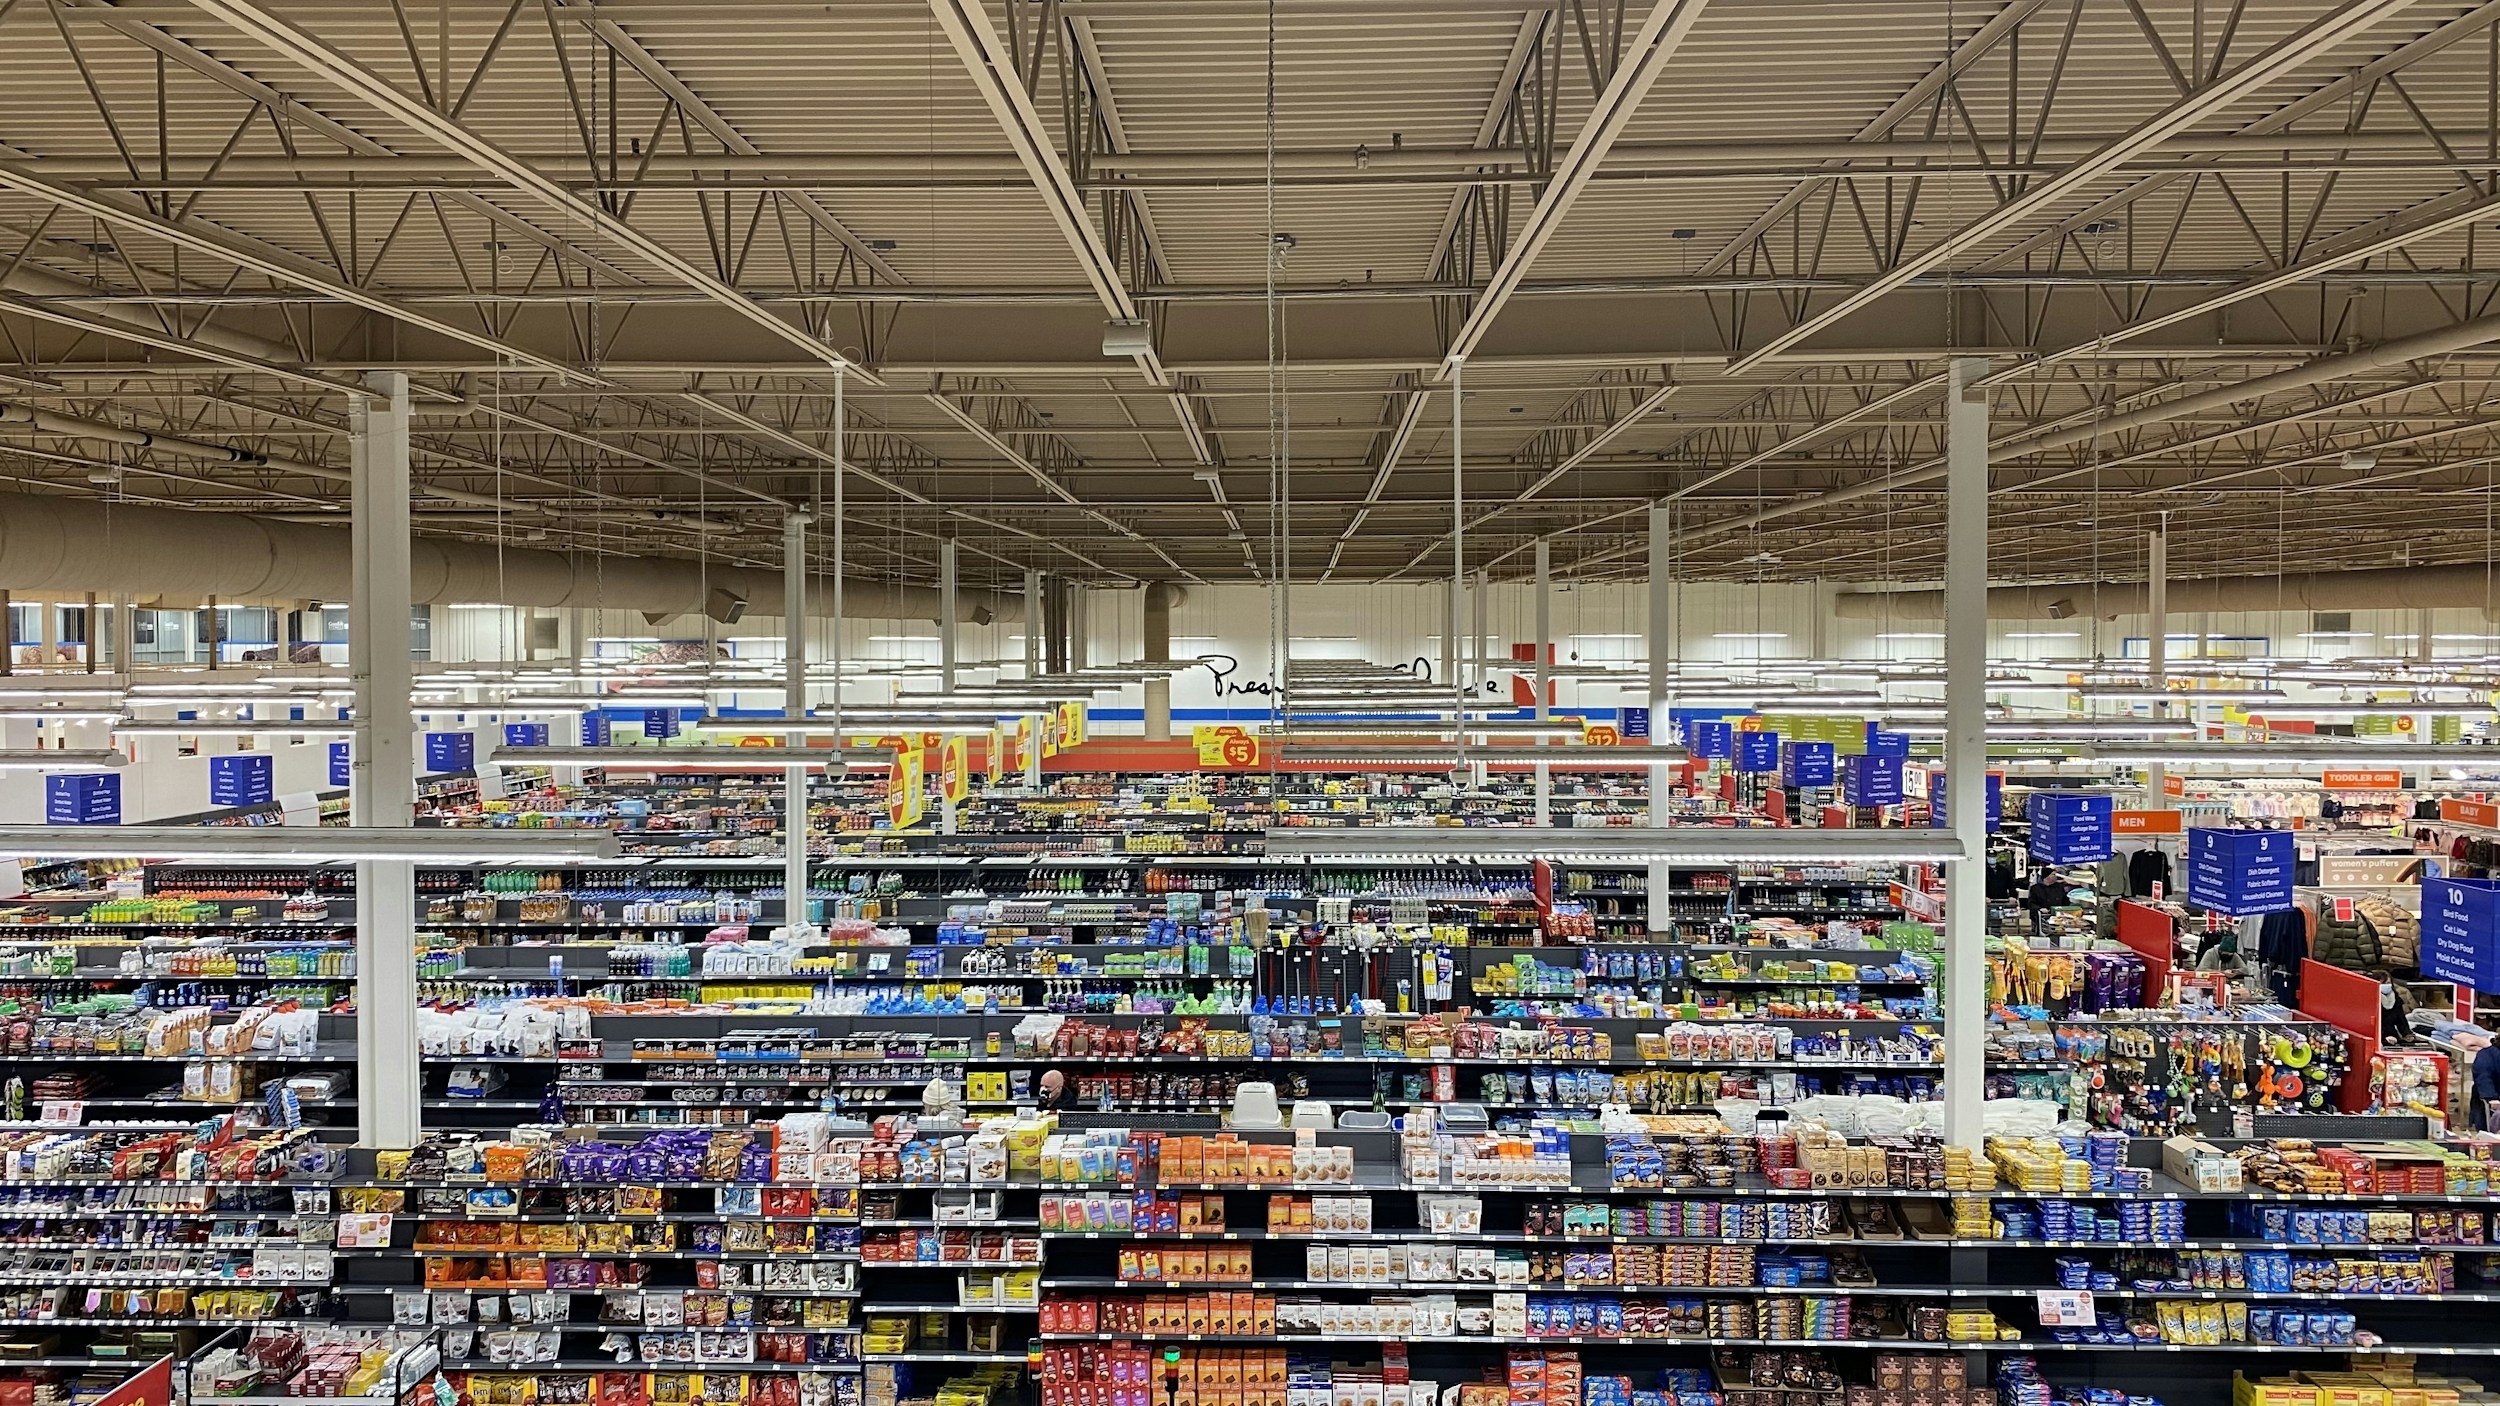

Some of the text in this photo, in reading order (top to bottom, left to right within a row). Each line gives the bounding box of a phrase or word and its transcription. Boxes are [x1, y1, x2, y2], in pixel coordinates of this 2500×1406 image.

[1587, 734, 1613, 746] $12
[1758, 734, 1764, 742] 4
[1812, 745, 1819, 753] 5
[1229, 746, 1249, 763] $5
[224, 760, 229, 768] 6
[256, 759, 261, 767] 6
[1879, 759, 1885, 767] 6
[98, 777, 105, 787] 7
[2328, 773, 2396, 782] TODDLER GIRL
[60, 779, 65, 788] 7
[891, 778, 903, 793] CLUB
[892, 790, 904, 808] SIZE
[2081, 800, 2089, 812] 8
[2460, 805, 2480, 817] BABY
[2084, 815, 2097, 823] Wrap
[2119, 817, 2146, 827] MEN
[2071, 825, 2089, 833] Garbage
[2207, 834, 2214, 848] 9
[2260, 836, 2269, 851] 9
[2062, 855, 2084, 863] Disposable
[2255, 856, 2273, 864] Brooms
[2331, 859, 2399, 869] women's puffers
[2247, 866, 2280, 876] Dish Detergent
[2247, 879, 2280, 889] Fabric Softener
[2242, 892, 2266, 901] Household
[2447, 887, 2464, 906] 10
[2236, 902, 2291, 914] Liquid Laundry Detergent
[2443, 908, 2469, 923] Bird Food
[2443, 924, 2468, 937] Cat Litter
[2437, 937, 2474, 955] Dry Dog Food
[2436, 952, 2475, 970] Moist Cat Food
[2435, 966, 2476, 985] Pet Accessories
[1615, 1160, 1638, 1171] Whippet
[1639, 1160, 1662, 1170] Whippet
[1566, 1261, 1589, 1269] Whippet
[1590, 1260, 1612, 1268] Whippet
[1622, 1311, 1645, 1319] Whippet
[1646, 1311, 1668, 1320] Whippet
